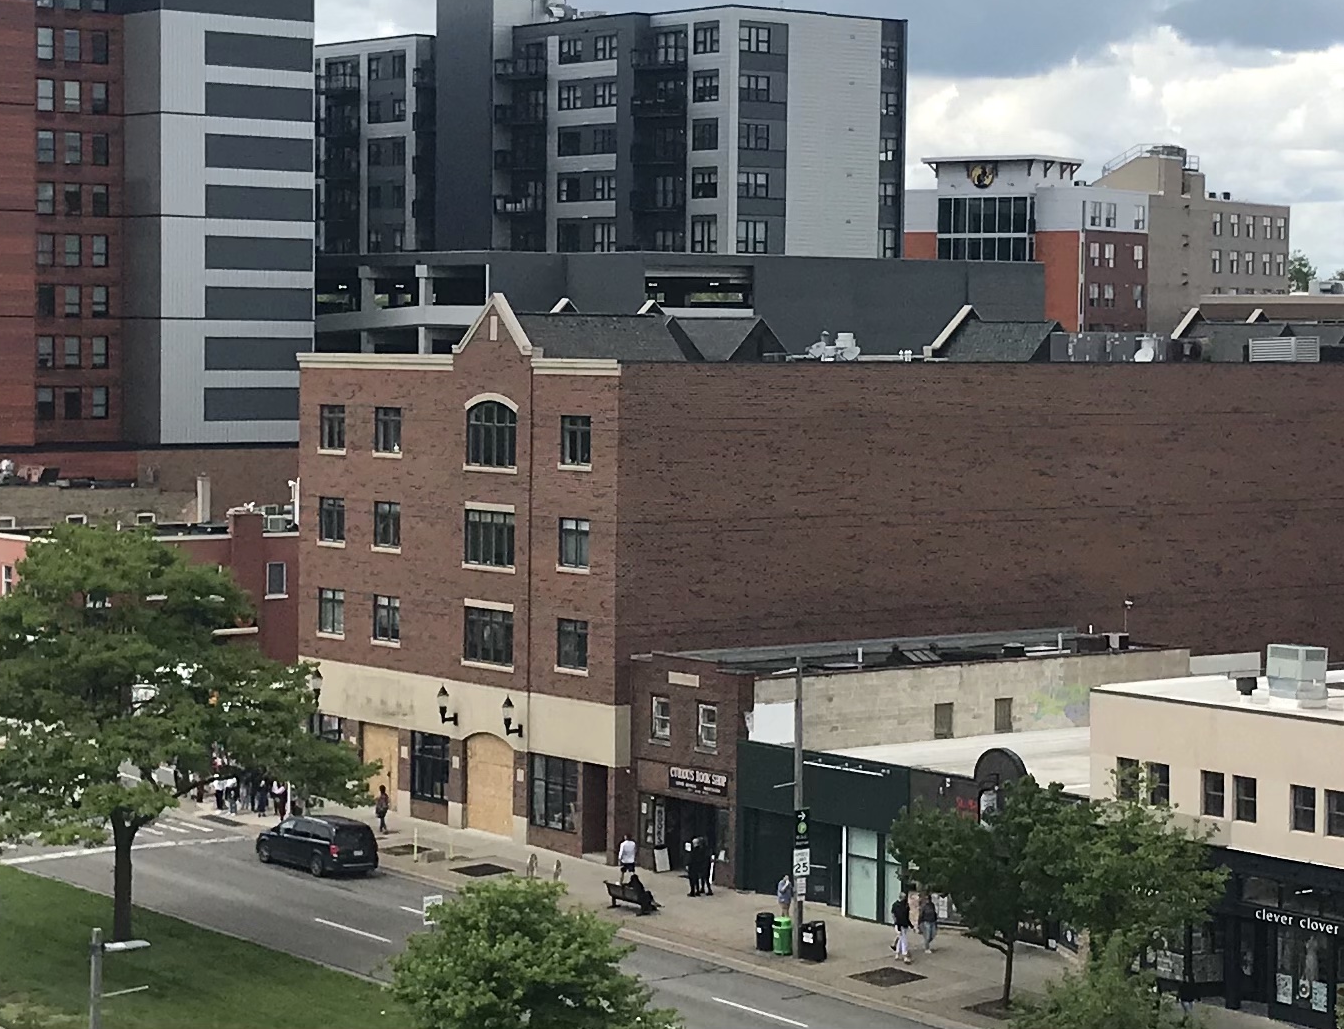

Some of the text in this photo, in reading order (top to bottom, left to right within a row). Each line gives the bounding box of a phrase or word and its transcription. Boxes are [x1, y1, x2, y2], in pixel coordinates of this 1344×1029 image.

[794, 862, 808, 873] 25
[1255, 908, 1339, 935] clever clover
